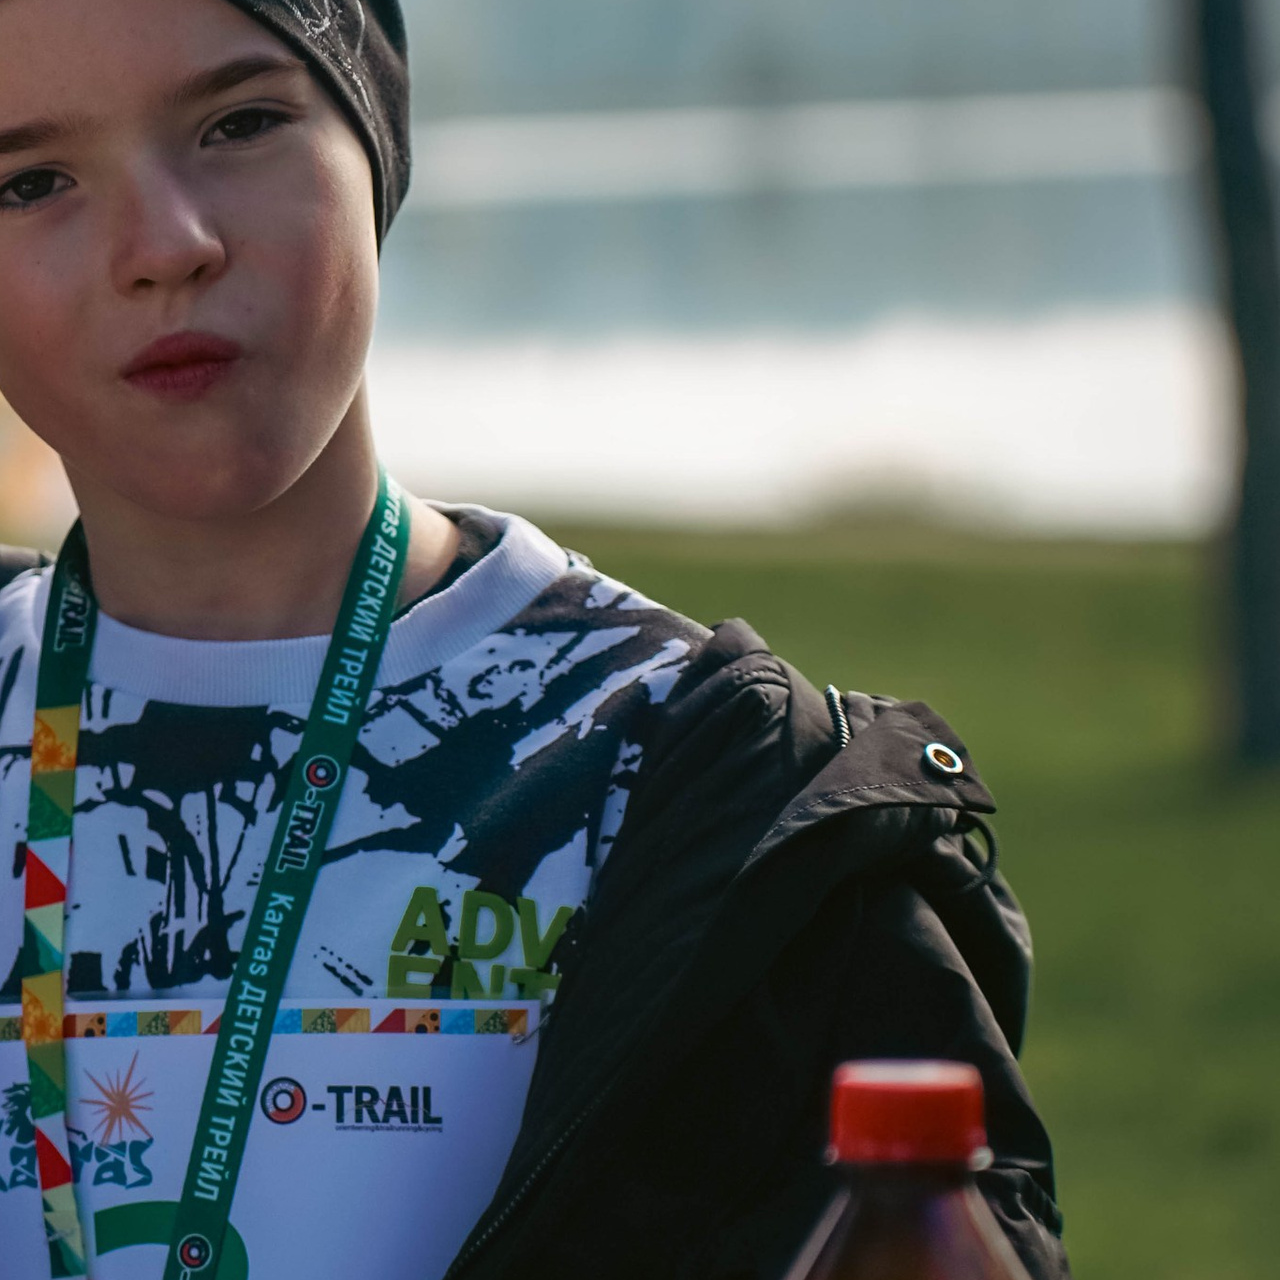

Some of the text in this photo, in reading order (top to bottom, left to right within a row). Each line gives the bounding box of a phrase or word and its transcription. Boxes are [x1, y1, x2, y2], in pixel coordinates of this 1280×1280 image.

[347, 534, 397, 642] ДЕТСКИЙ
[323, 647, 368, 725] ТРЕЙЛ
[391, 886, 573, 968] ADV
[194, 891, 295, 1202] Karras ДЕТСКИЙ ТРЕЙЛ
[260, 1076, 442, 1125] O-TRAIL
